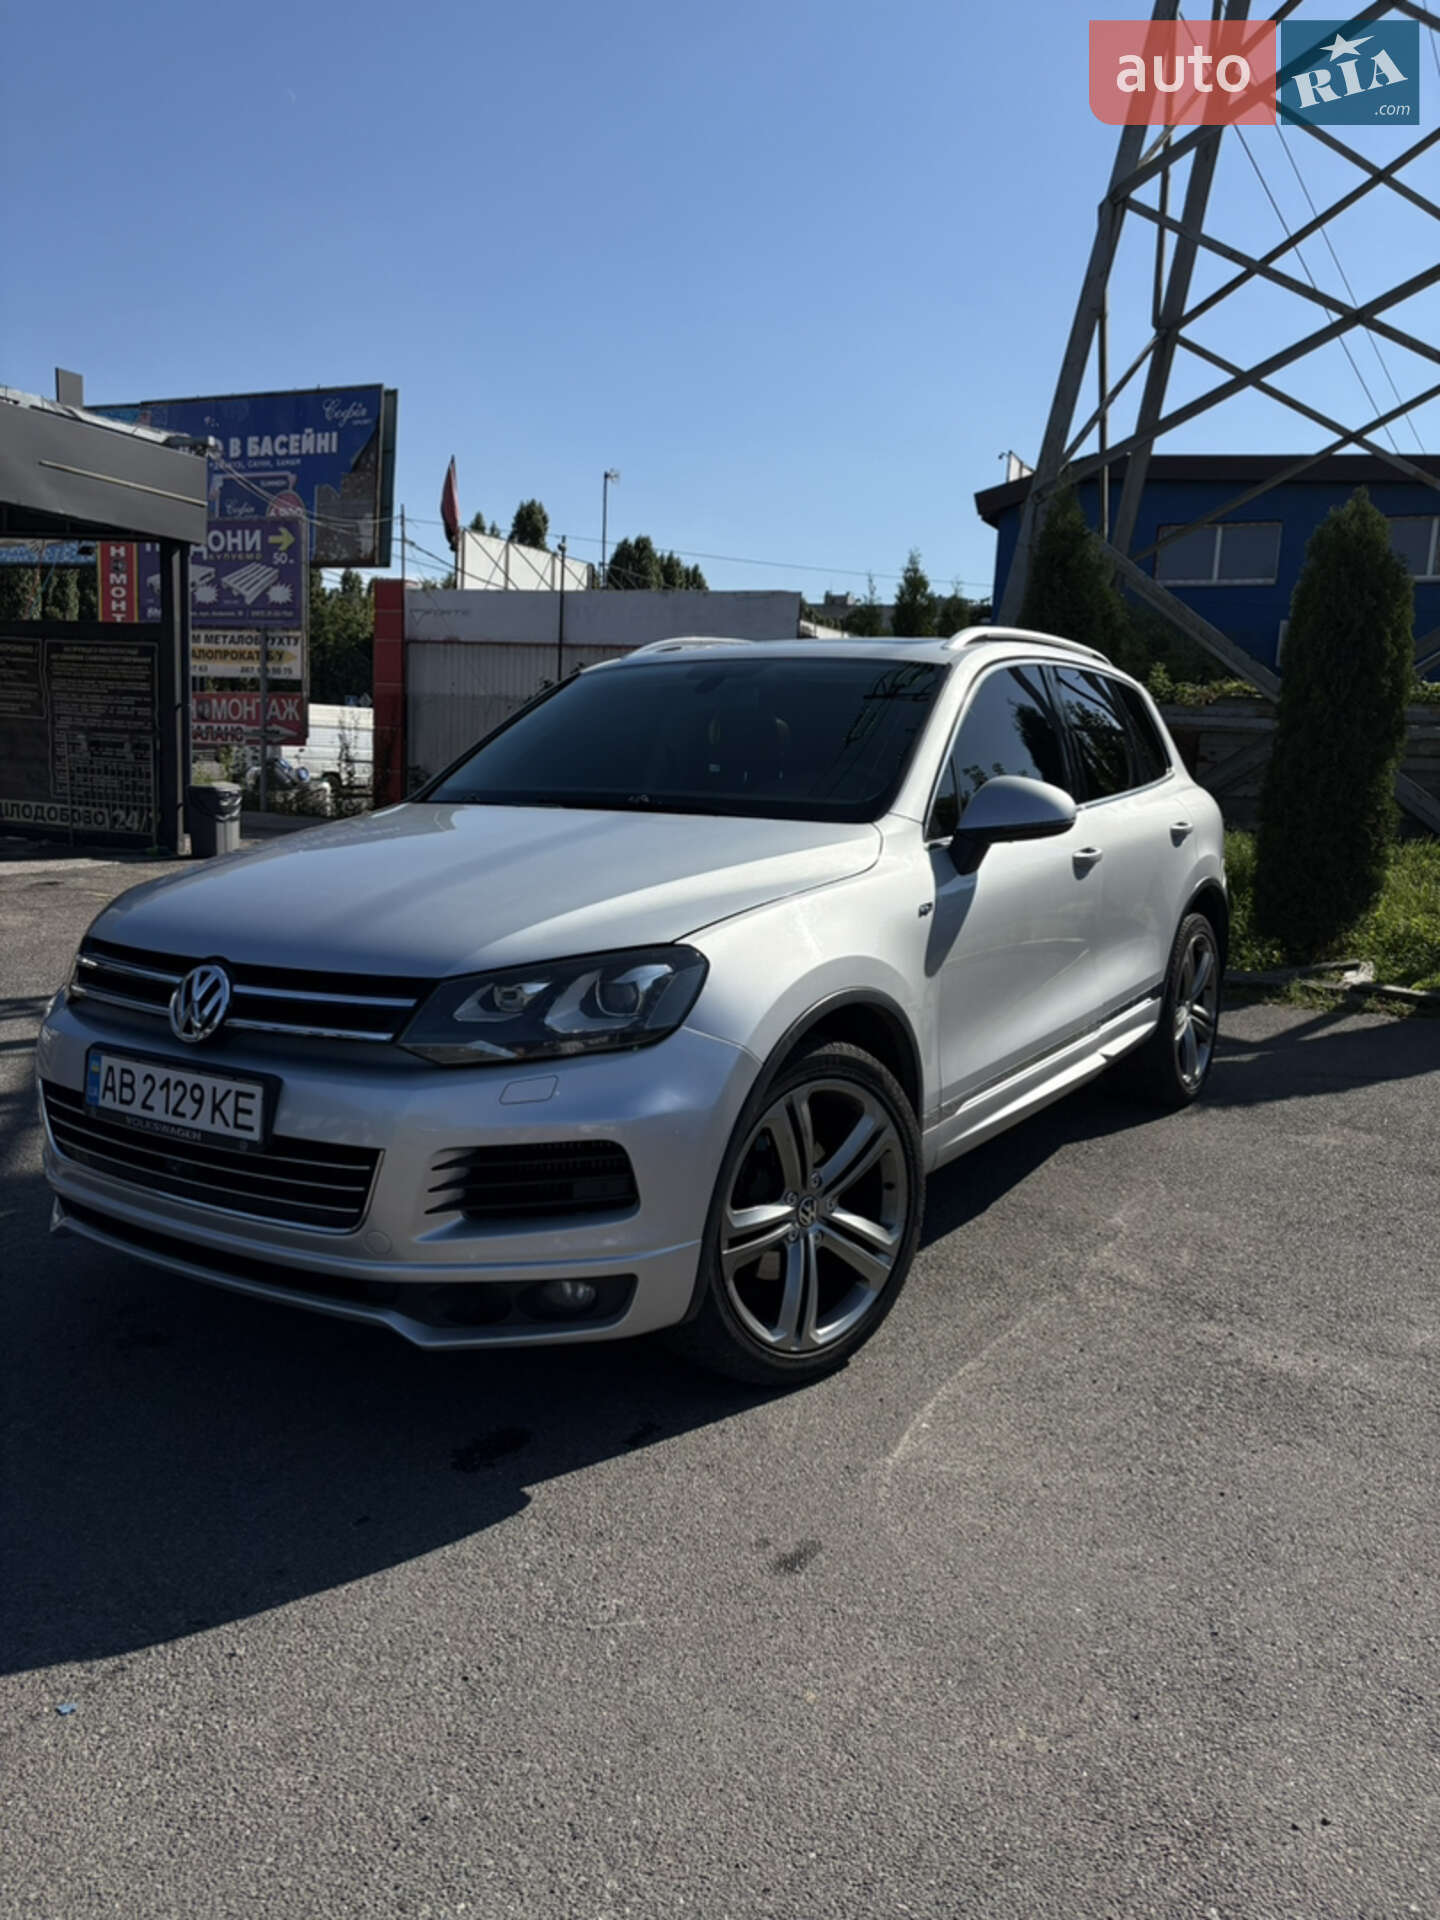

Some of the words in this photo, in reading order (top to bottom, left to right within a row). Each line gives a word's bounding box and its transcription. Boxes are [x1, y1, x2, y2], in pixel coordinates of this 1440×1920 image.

[247, 428, 338, 457] БАСЕЙНІ
[191, 724, 245, 743] АЛАНС
[101, 1064, 136, 1107] AB
[140, 1073, 205, 1121] 2129
[210, 1085, 256, 1133] KE
